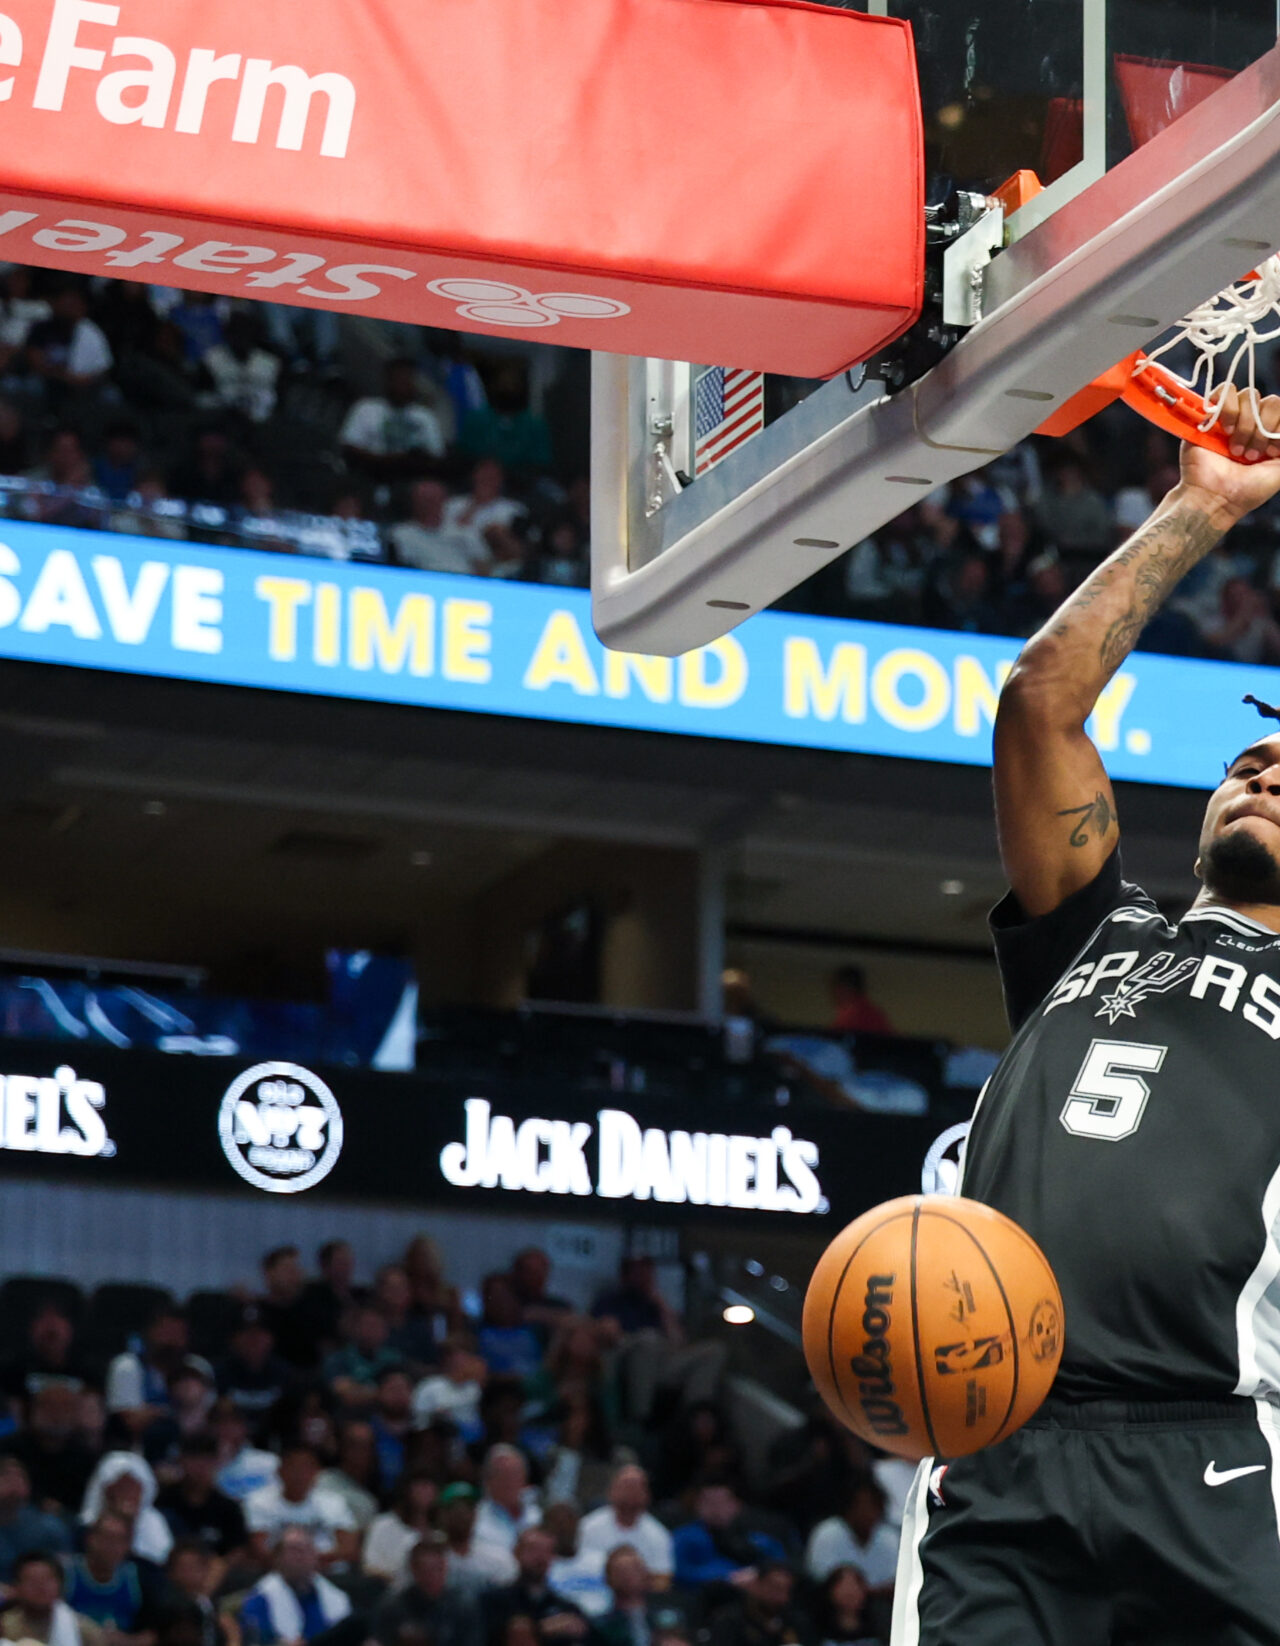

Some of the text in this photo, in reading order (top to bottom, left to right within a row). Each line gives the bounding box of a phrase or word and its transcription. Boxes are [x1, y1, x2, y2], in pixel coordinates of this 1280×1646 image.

[32, 0, 357, 158] Farm
[32, 218, 418, 301] State
[256, 574, 493, 684] TIME
[523, 609, 749, 709] AND
[783, 635, 1152, 755] MONY.
[0, 1065, 109, 1157] EL'S
[1058, 1038, 1169, 1142] 5
[850, 1272, 910, 1437] Wilson
